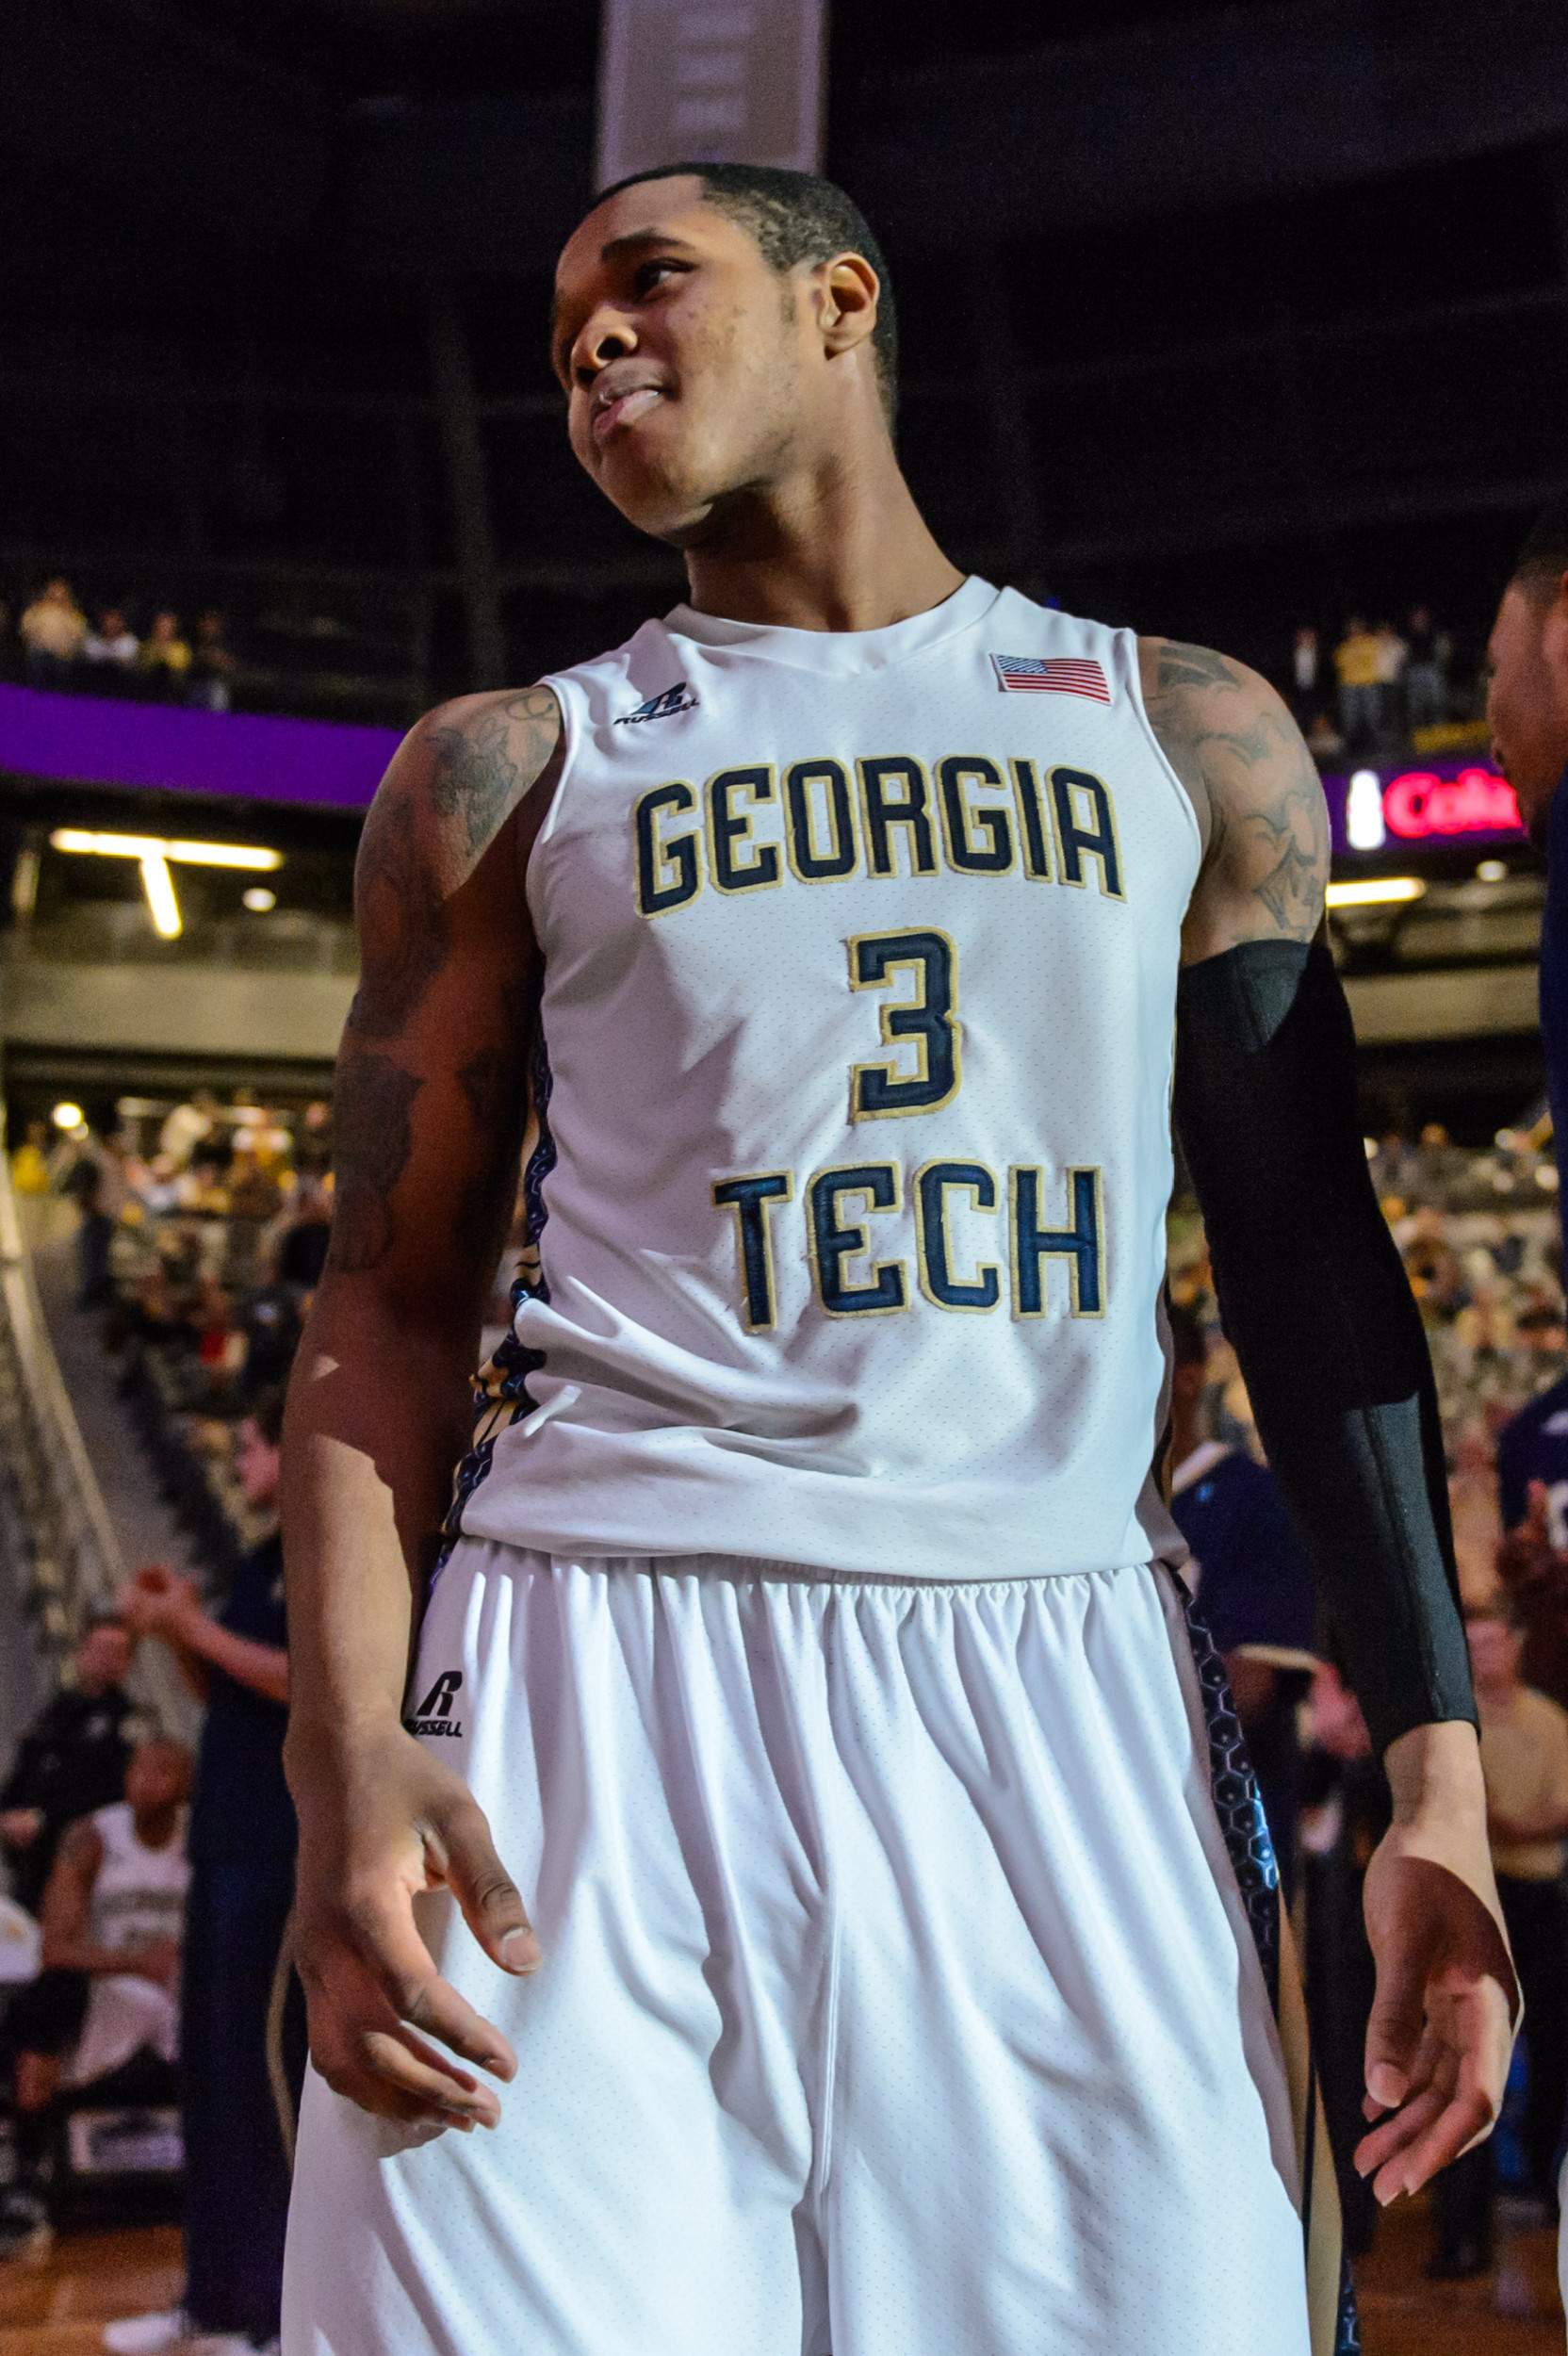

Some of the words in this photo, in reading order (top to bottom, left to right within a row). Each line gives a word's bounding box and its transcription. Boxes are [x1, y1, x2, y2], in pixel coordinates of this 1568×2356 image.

[635, 755, 1126, 919] GEORGIA
[847, 926, 961, 1122] 3
[711, 1158, 1105, 1333] TECH
